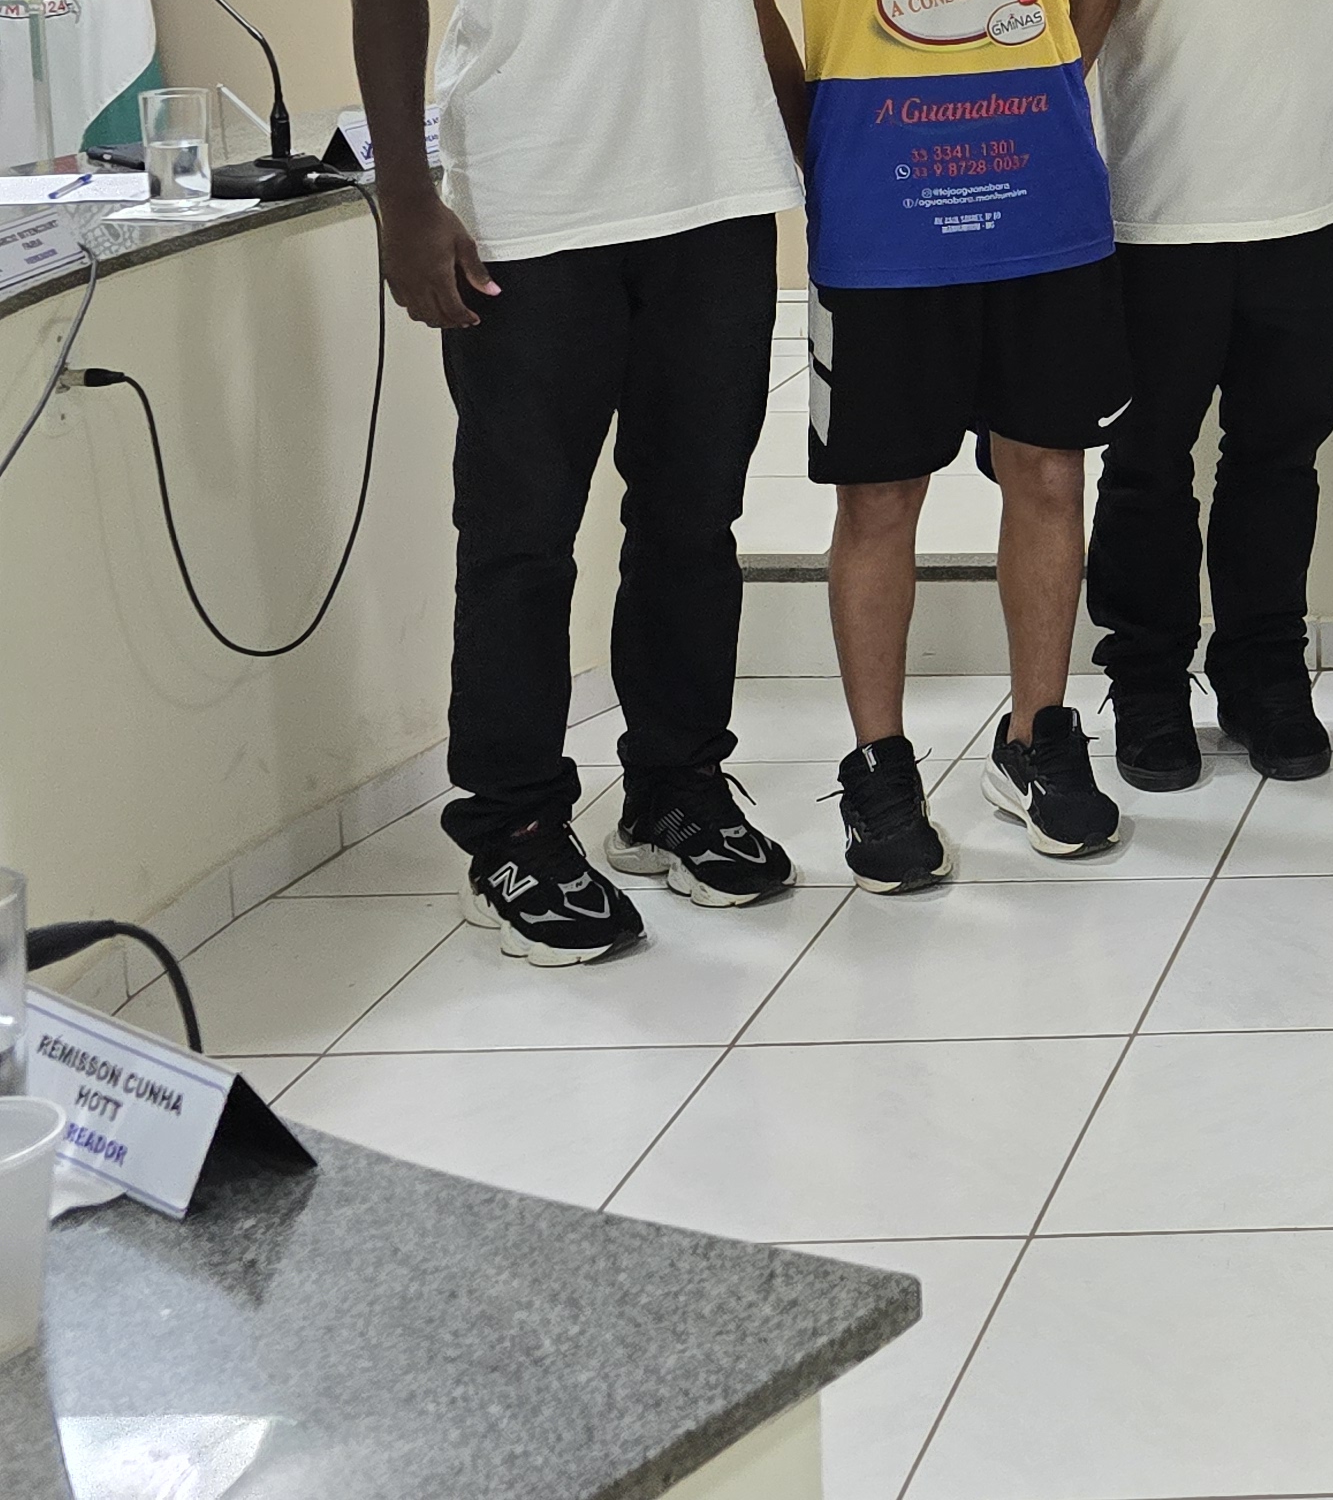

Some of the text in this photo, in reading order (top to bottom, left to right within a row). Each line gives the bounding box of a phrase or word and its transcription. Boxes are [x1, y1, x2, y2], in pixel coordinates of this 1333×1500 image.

[891, 0, 904, 18] A
[901, 92, 1049, 124] Guanabara
[75, 1084, 124, 1122] HOTT
[122, 1072, 186, 1116] CUNHA
[64, 1121, 129, 1168] READOR
